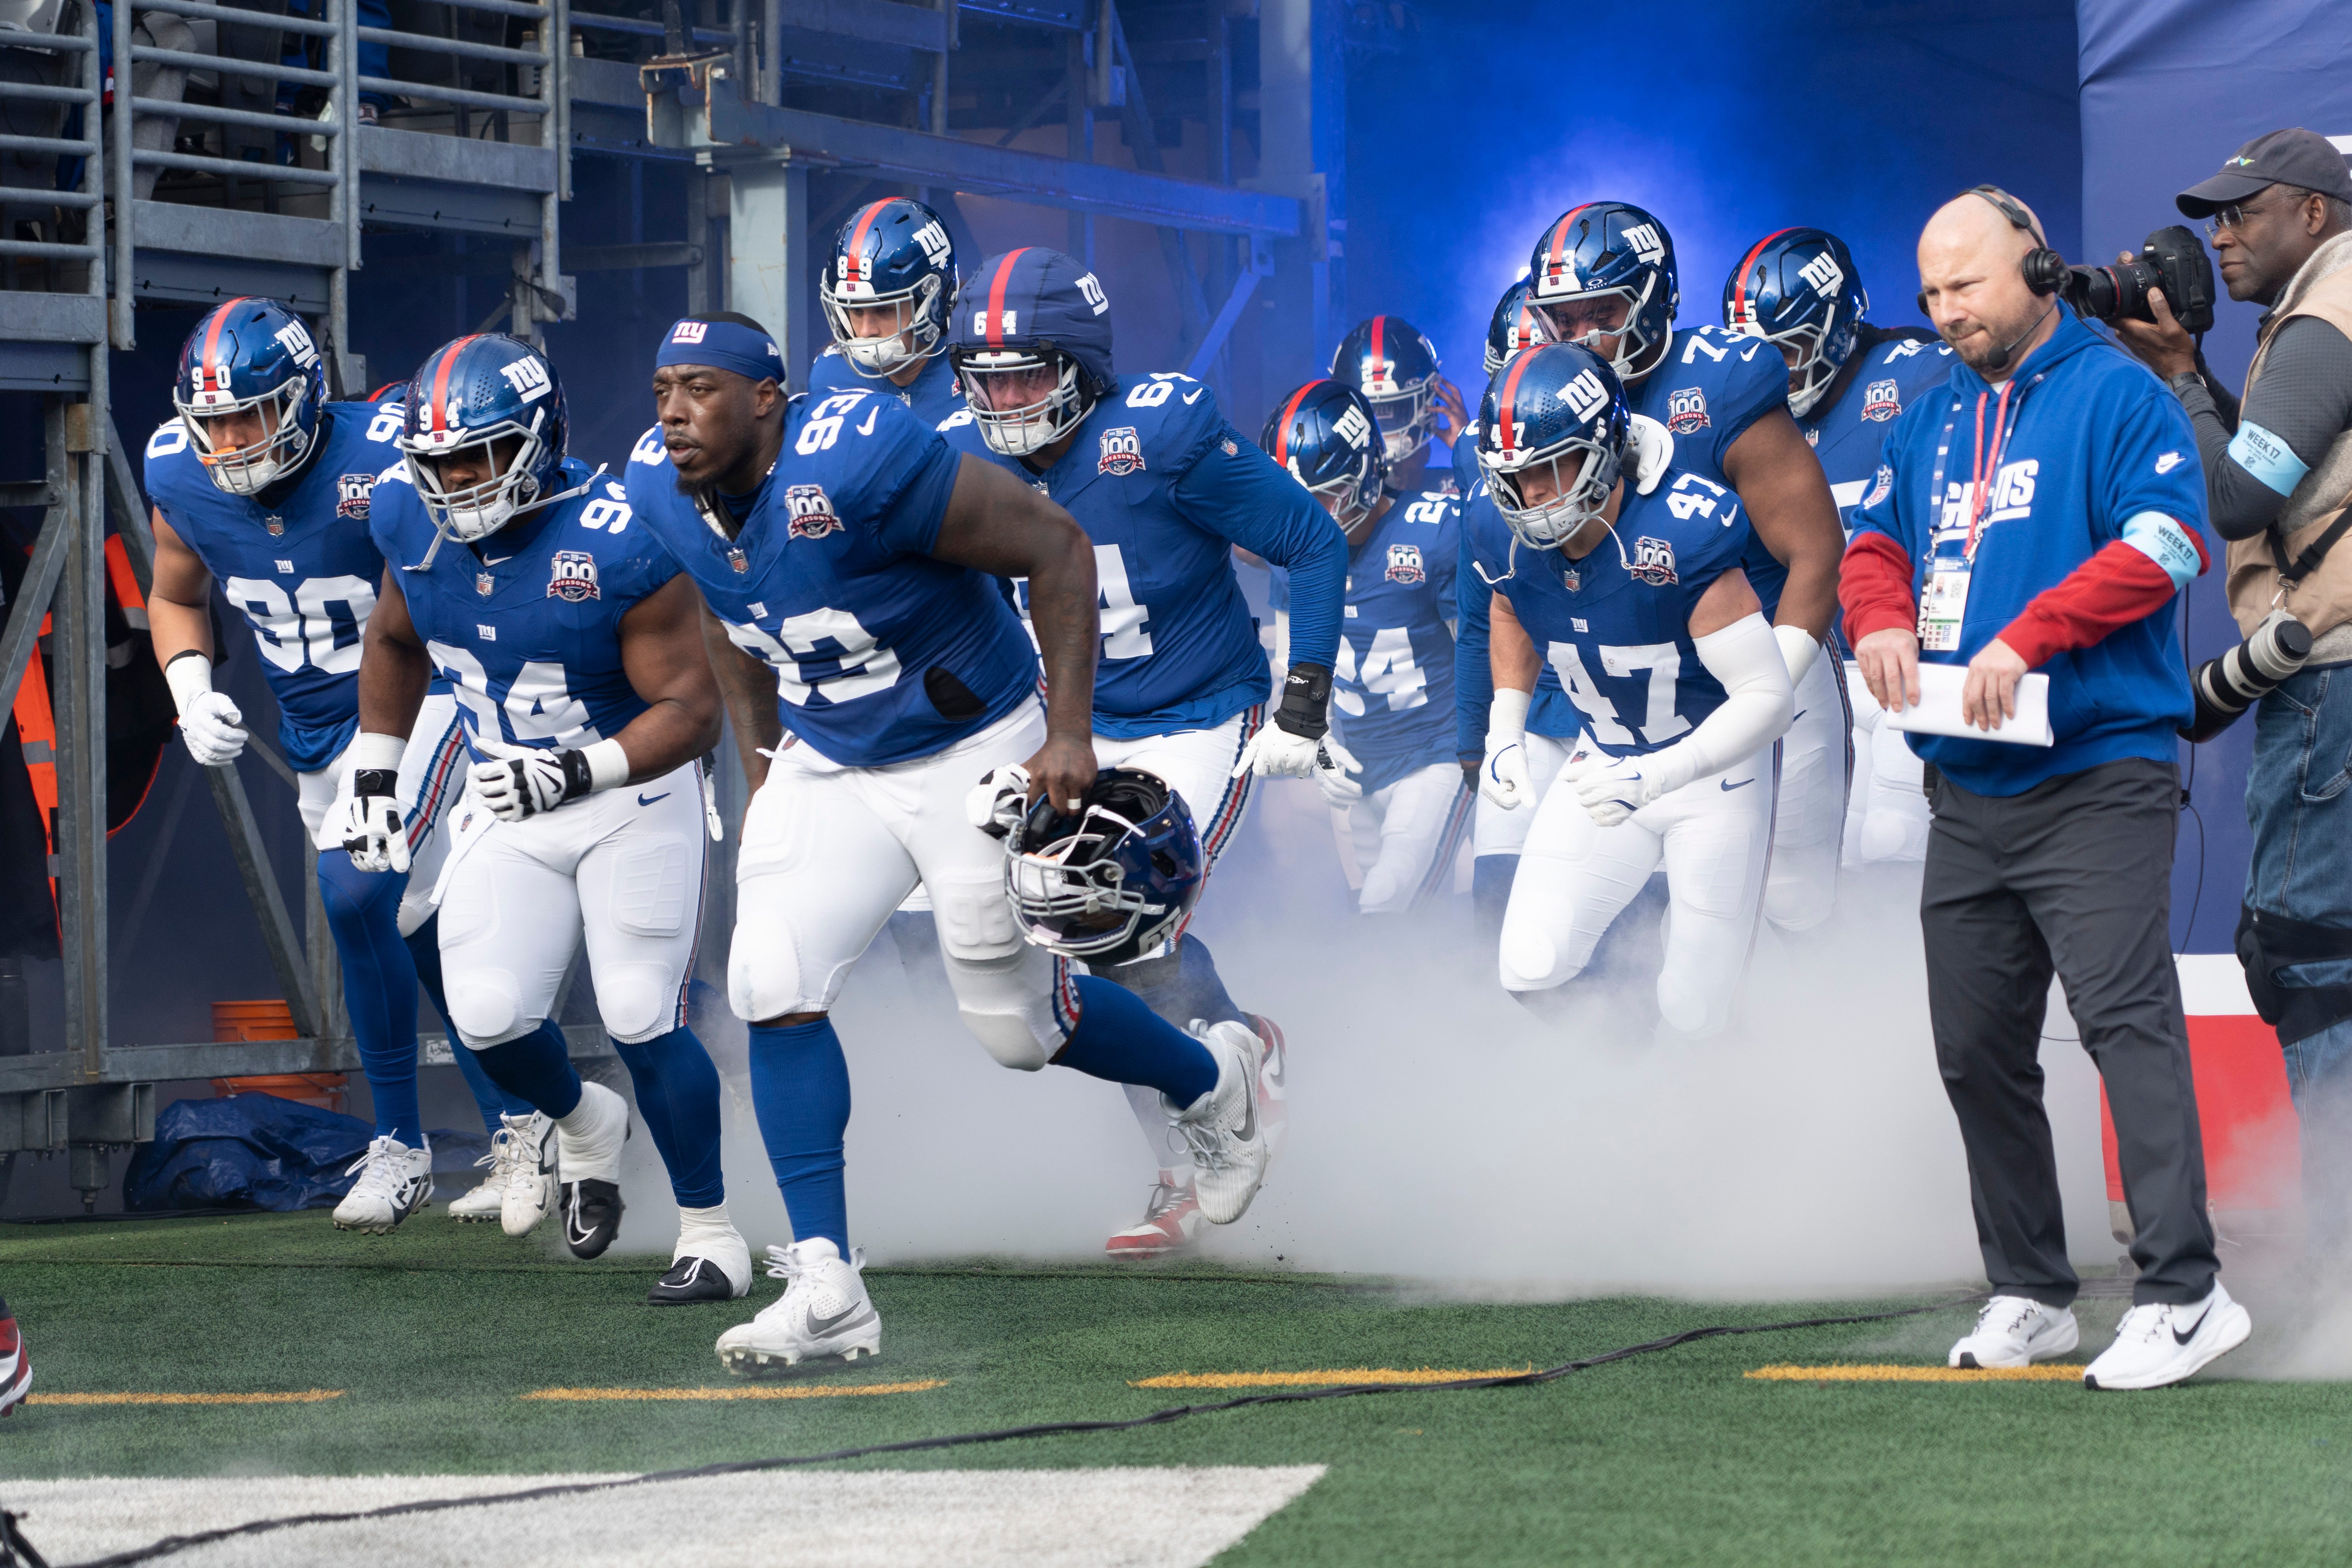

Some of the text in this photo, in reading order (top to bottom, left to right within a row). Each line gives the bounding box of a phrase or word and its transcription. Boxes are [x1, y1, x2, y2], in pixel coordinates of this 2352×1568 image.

[912, 220, 951, 265] ny
[1621, 223, 1665, 263] ny
[837, 255, 872, 280] 89
[1541, 250, 1575, 276] 73
[1798, 252, 1843, 299] ny
[1075, 272, 1108, 316] ny
[1585, 282, 1607, 291] OAKLEY
[974, 310, 1017, 335] 64
[1728, 300, 1757, 322] 75
[274, 320, 315, 365] ny
[672, 322, 708, 343] ny
[192, 365, 231, 390] 90
[499, 355, 552, 403] ny
[1361, 361, 1395, 382] 27
[1556, 369, 1609, 424] ny
[1669, 395, 1704, 418] 100
[1866, 386, 1896, 407] 100
[419, 402, 459, 431] 94
[795, 393, 866, 455] 93
[1332, 405, 1371, 450] ny
[1673, 414, 1702, 423] SEASONS
[1101, 436, 1138, 458] 100
[1491, 422, 1525, 448] 47
[2248, 429, 2271, 453] WEEK
[2270, 446, 2281, 459] 17
[340, 483, 374, 502] 100
[1667, 473, 1727, 520] 47
[1941, 459, 2039, 530] GITS
[787, 496, 830, 520] 100
[795, 516, 830, 525] SEASONS
[2159, 525, 2186, 552] WEEK
[2184, 547, 2193, 560] 17
[275, 560, 294, 573] ny
[1389, 552, 1421, 569] 100
[1637, 545, 1673, 569] 100
[554, 560, 595, 583] 100
[227, 575, 377, 674] 90
[476, 624, 496, 641] ny
[1570, 617, 1588, 633] ny
[720, 607, 902, 706] 93
[1547, 641, 1693, 745] 47
